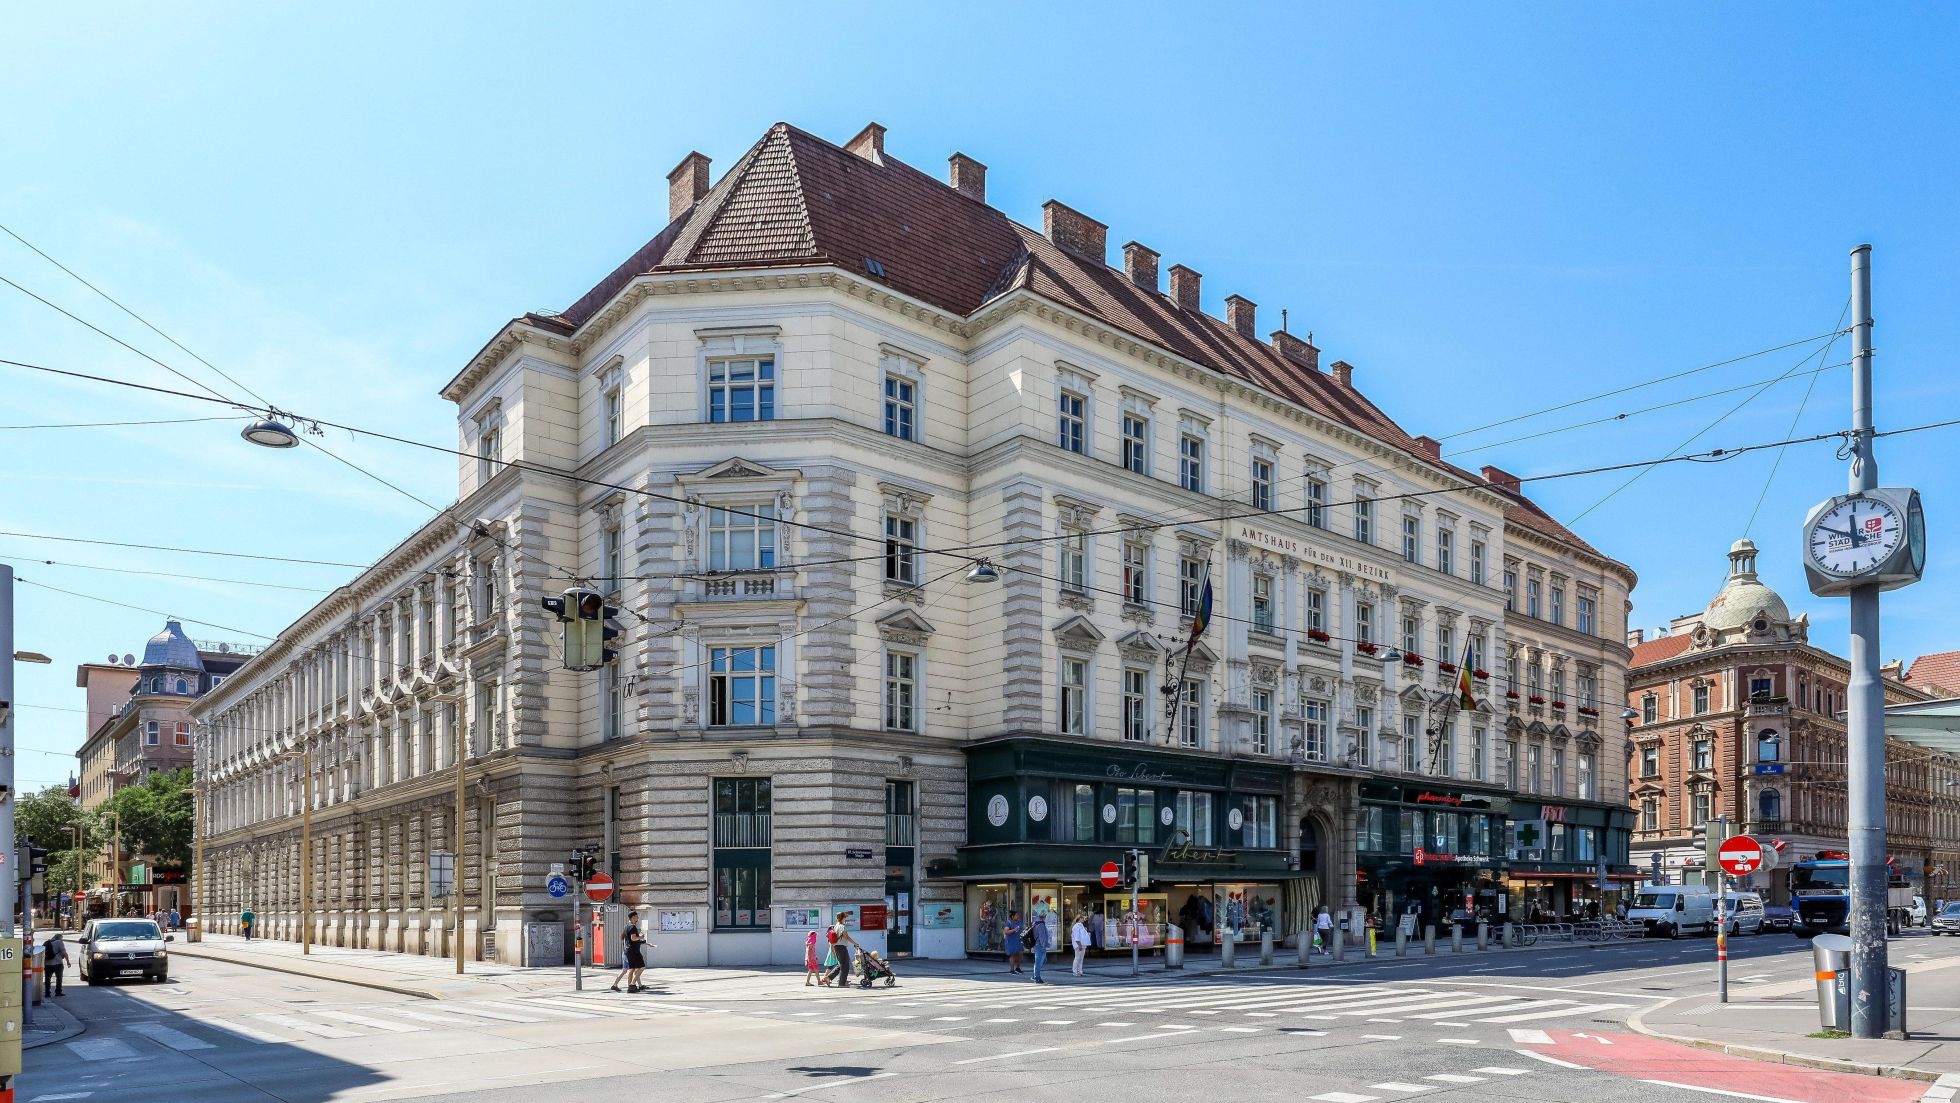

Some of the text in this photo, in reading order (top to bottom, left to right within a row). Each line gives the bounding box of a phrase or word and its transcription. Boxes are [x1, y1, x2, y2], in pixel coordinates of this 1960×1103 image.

[1242, 527, 1297, 552] AMTSHAUS
[1304, 547, 1317, 558] FÜR
[1320, 552, 1335, 563] DEN
[1357, 562, 1389, 580] BEZIRK
